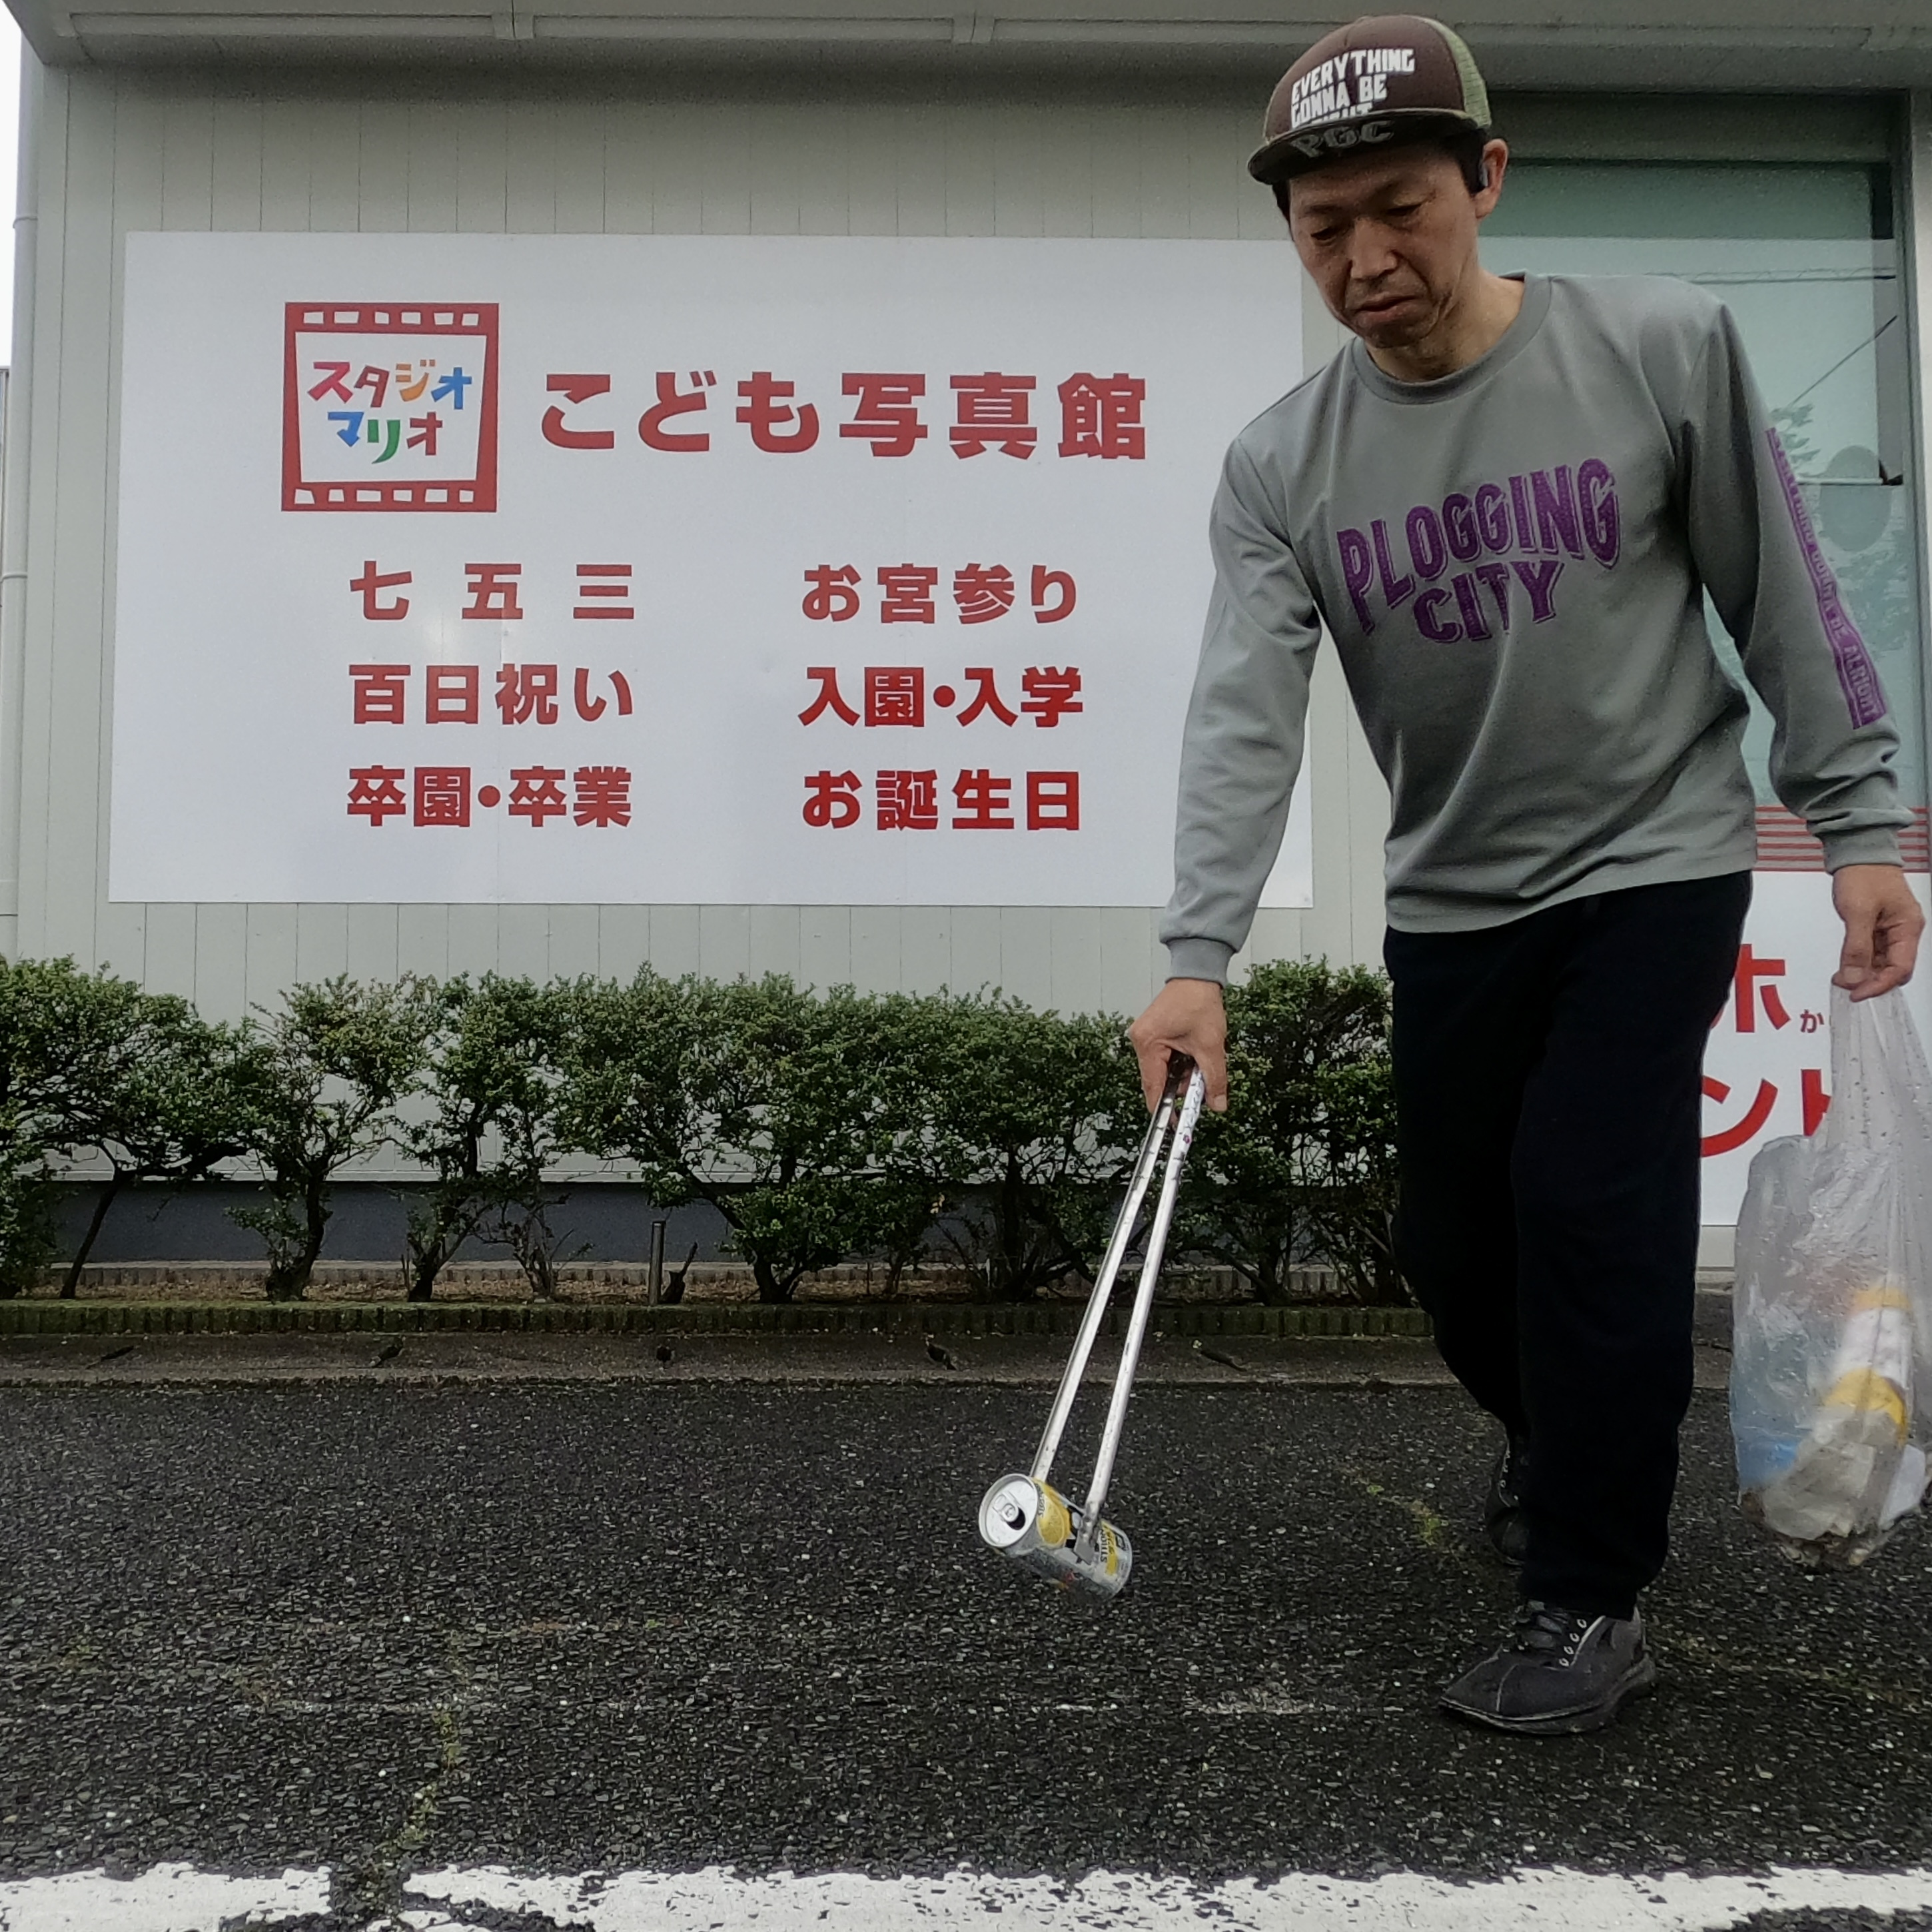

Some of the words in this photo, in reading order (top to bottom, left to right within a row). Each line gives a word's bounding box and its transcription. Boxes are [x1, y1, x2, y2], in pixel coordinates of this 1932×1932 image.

[1290, 81, 1350, 129] GONNA
[1359, 73, 1388, 103] BE
[1291, 48, 1416, 103] EVERYTHING
[308, 358, 472, 410] スタジオ
[327, 410, 443, 464] マリオ
[540, 370, 1147, 461] こども写真館
[1336, 458, 1620, 636] PLOGGING
[801, 563, 1077, 625] お宮参り
[1413, 560, 1565, 644] CITY
[348, 664, 634, 725] 百日祝い
[797, 666, 1084, 728] 入園・入学
[346, 765, 632, 828] 卒園・卒業
[802, 769, 1081, 831] お誕生日
